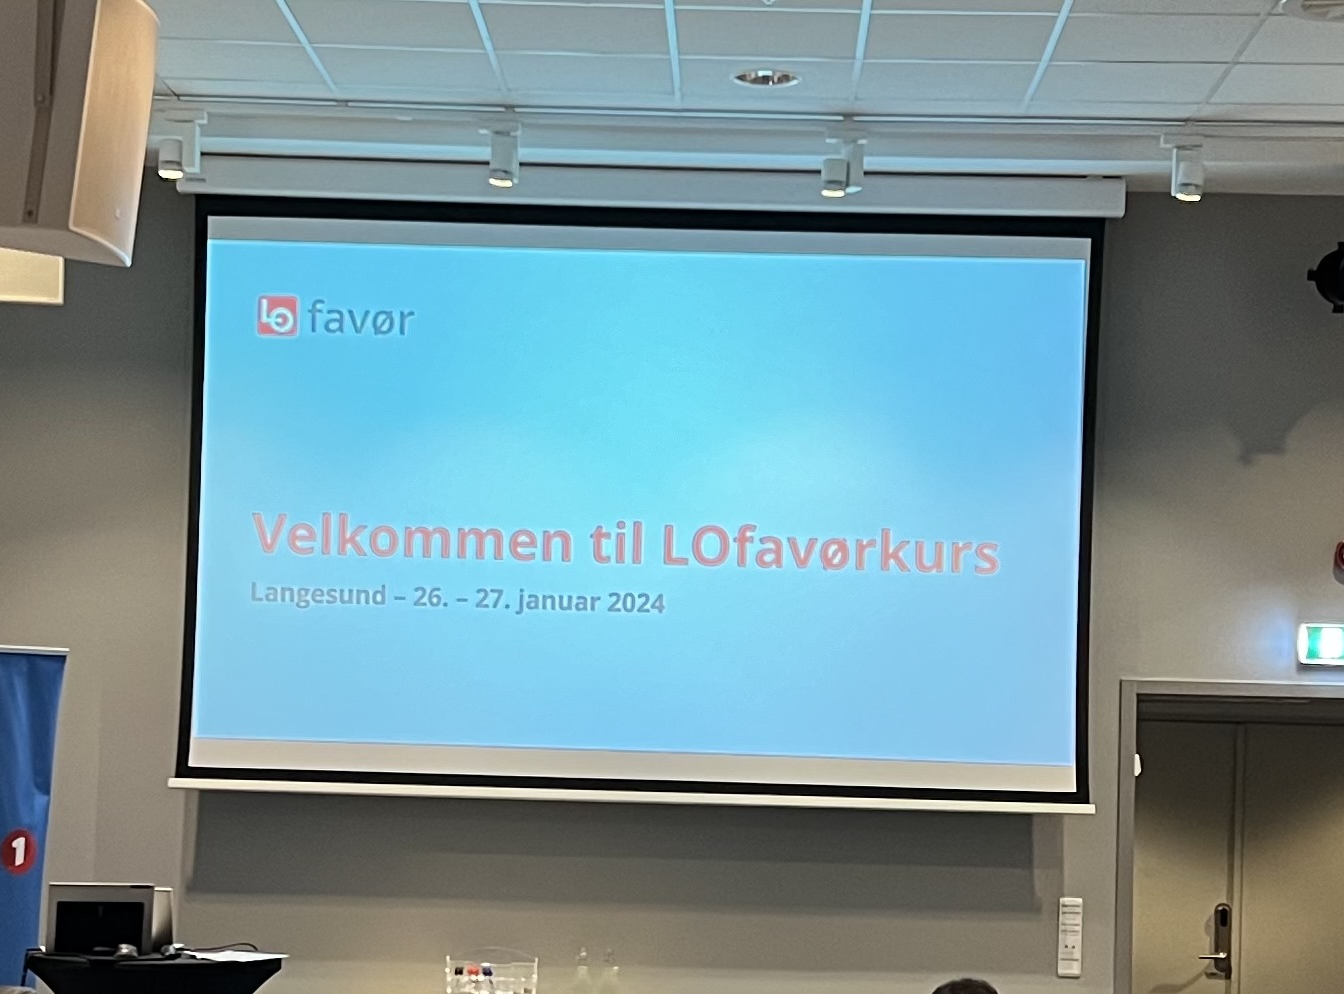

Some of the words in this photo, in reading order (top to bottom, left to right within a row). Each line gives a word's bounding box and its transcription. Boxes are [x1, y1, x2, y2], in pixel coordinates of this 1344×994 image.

[308, 299, 415, 336] favør
[252, 512, 572, 563] Velkommen
[590, 521, 644, 565] til
[662, 523, 999, 575] LOfavørkurs
[251, 582, 387, 609] Langesund
[413, 586, 449, 608] 26.
[475, 588, 511, 610] 27.
[515, 588, 602, 615] januar
[607, 591, 666, 614] 2024
[11, 836, 26, 867] 1
